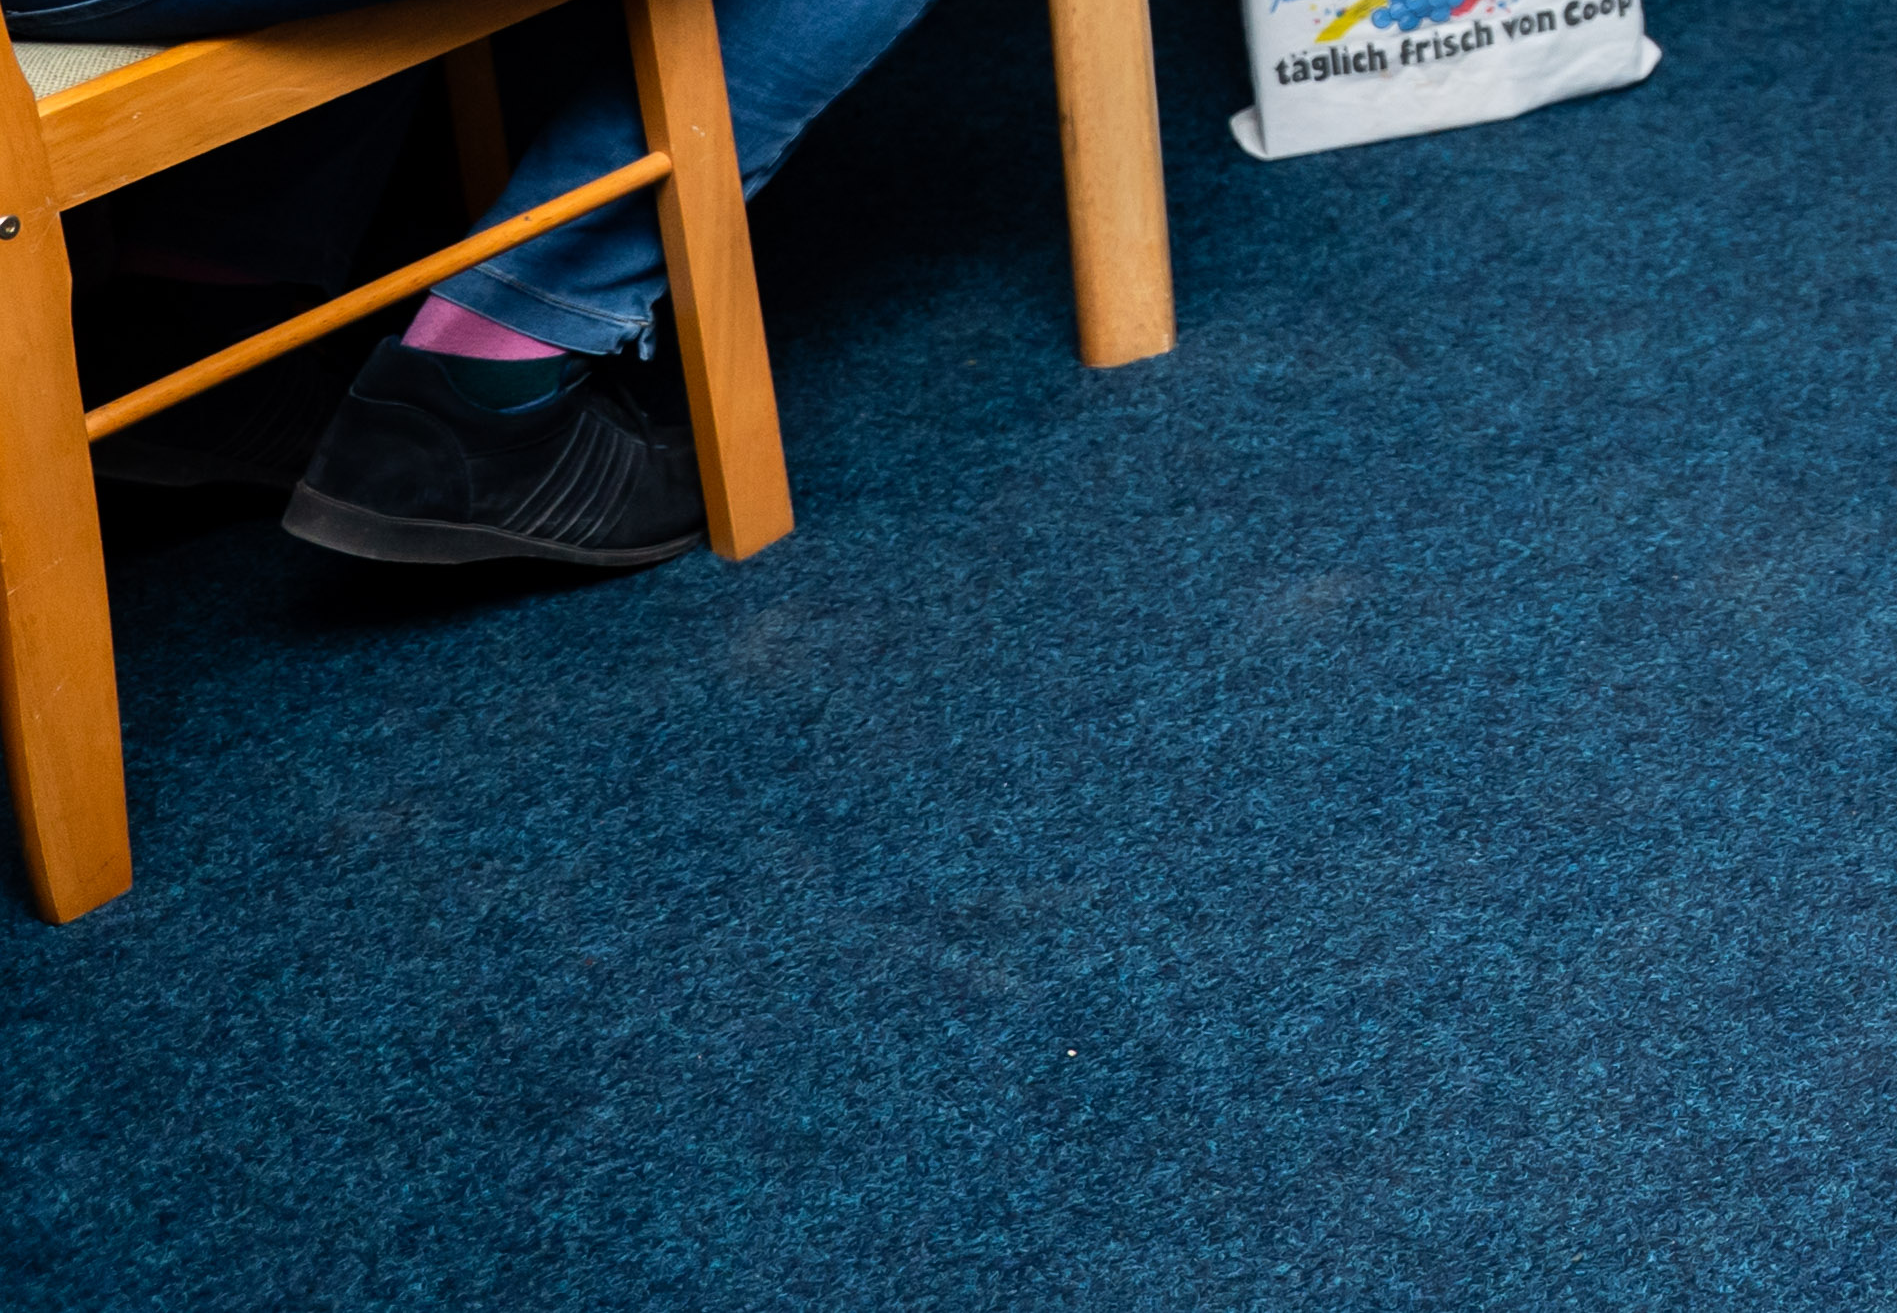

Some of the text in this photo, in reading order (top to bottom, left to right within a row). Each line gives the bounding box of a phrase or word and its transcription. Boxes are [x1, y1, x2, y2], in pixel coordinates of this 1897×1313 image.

[1273, 41, 1389, 86] täglich
[1399, 18, 1495, 66] frisch
[1501, 9, 1557, 41] von
